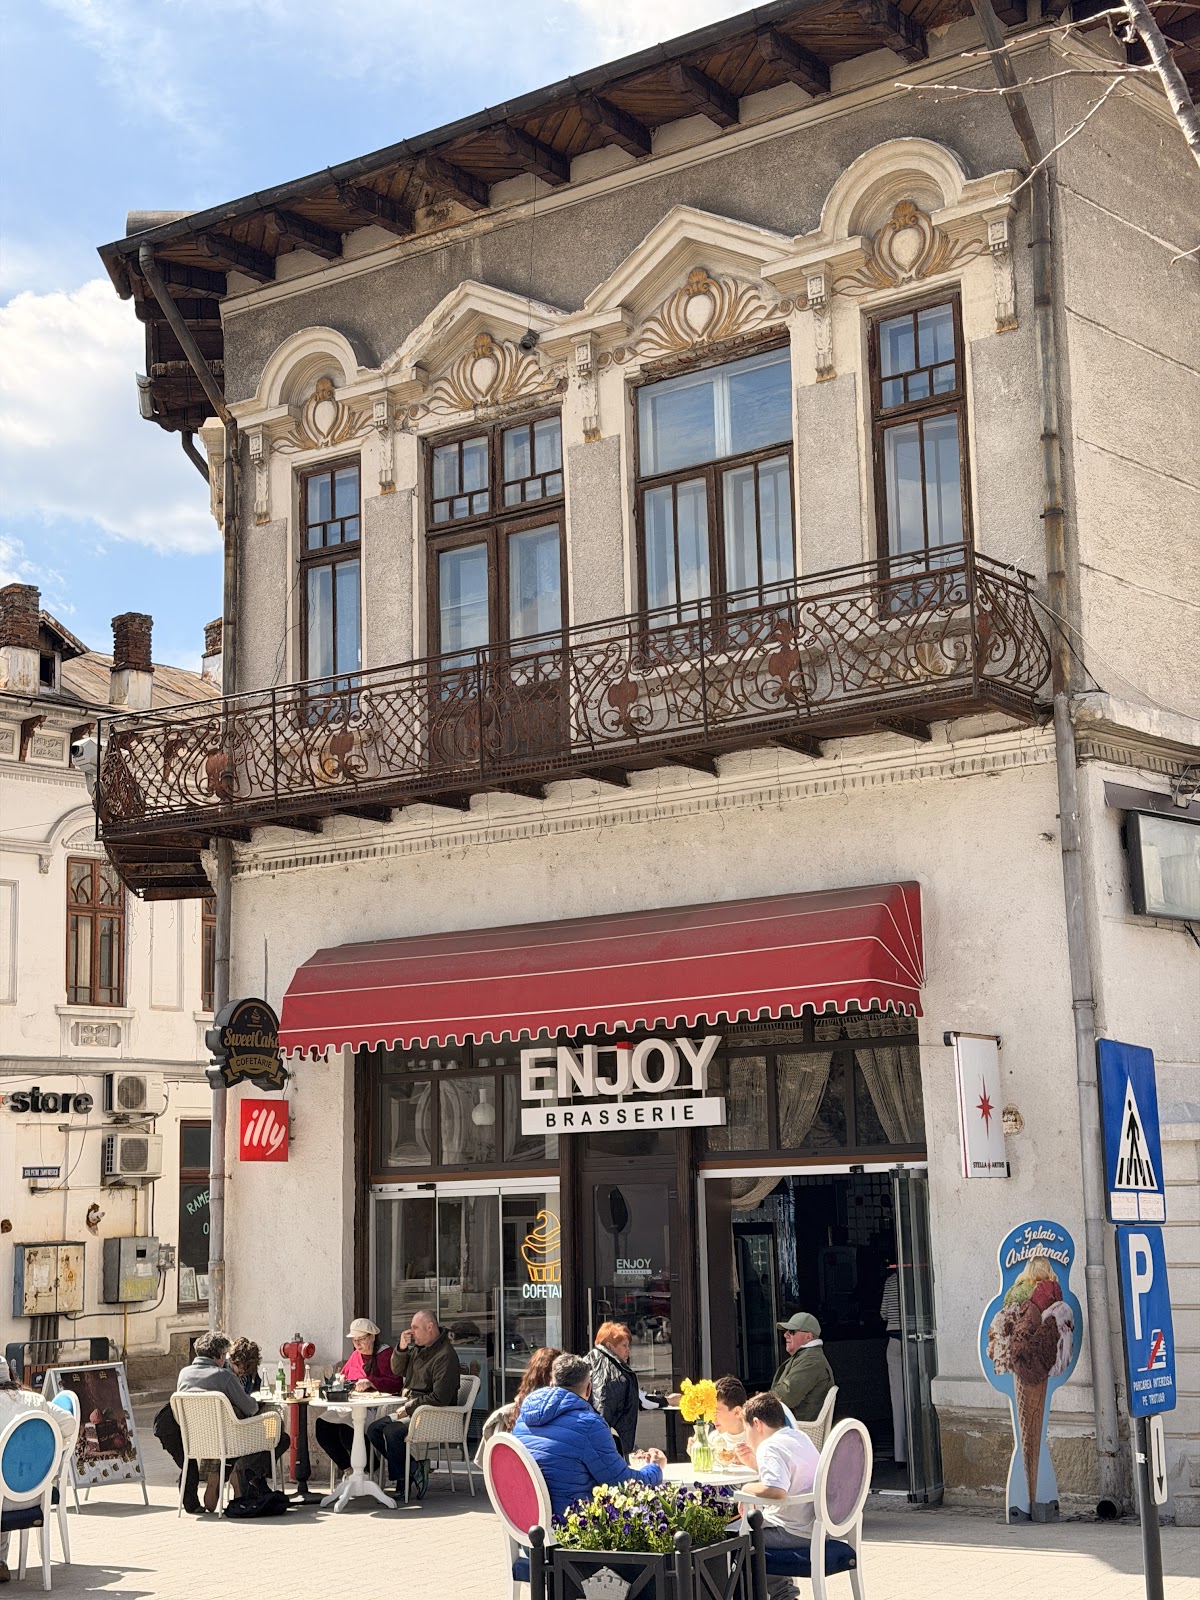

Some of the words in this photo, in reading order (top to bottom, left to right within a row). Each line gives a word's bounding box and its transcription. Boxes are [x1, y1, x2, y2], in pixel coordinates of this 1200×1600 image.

[520, 1035, 722, 1100] ENJOY
[10, 1086, 93, 1114] store
[546, 1105, 695, 1127] BRASSERIE
[243, 1108, 286, 1156] illy
[1023, 1225, 1056, 1244] Gelato
[616, 1258, 651, 1269] ENJOY
[1005, 1242, 1070, 1268] Artigianale
[522, 1283, 562, 1299] COFETA
[1128, 1233, 1153, 1340] P
